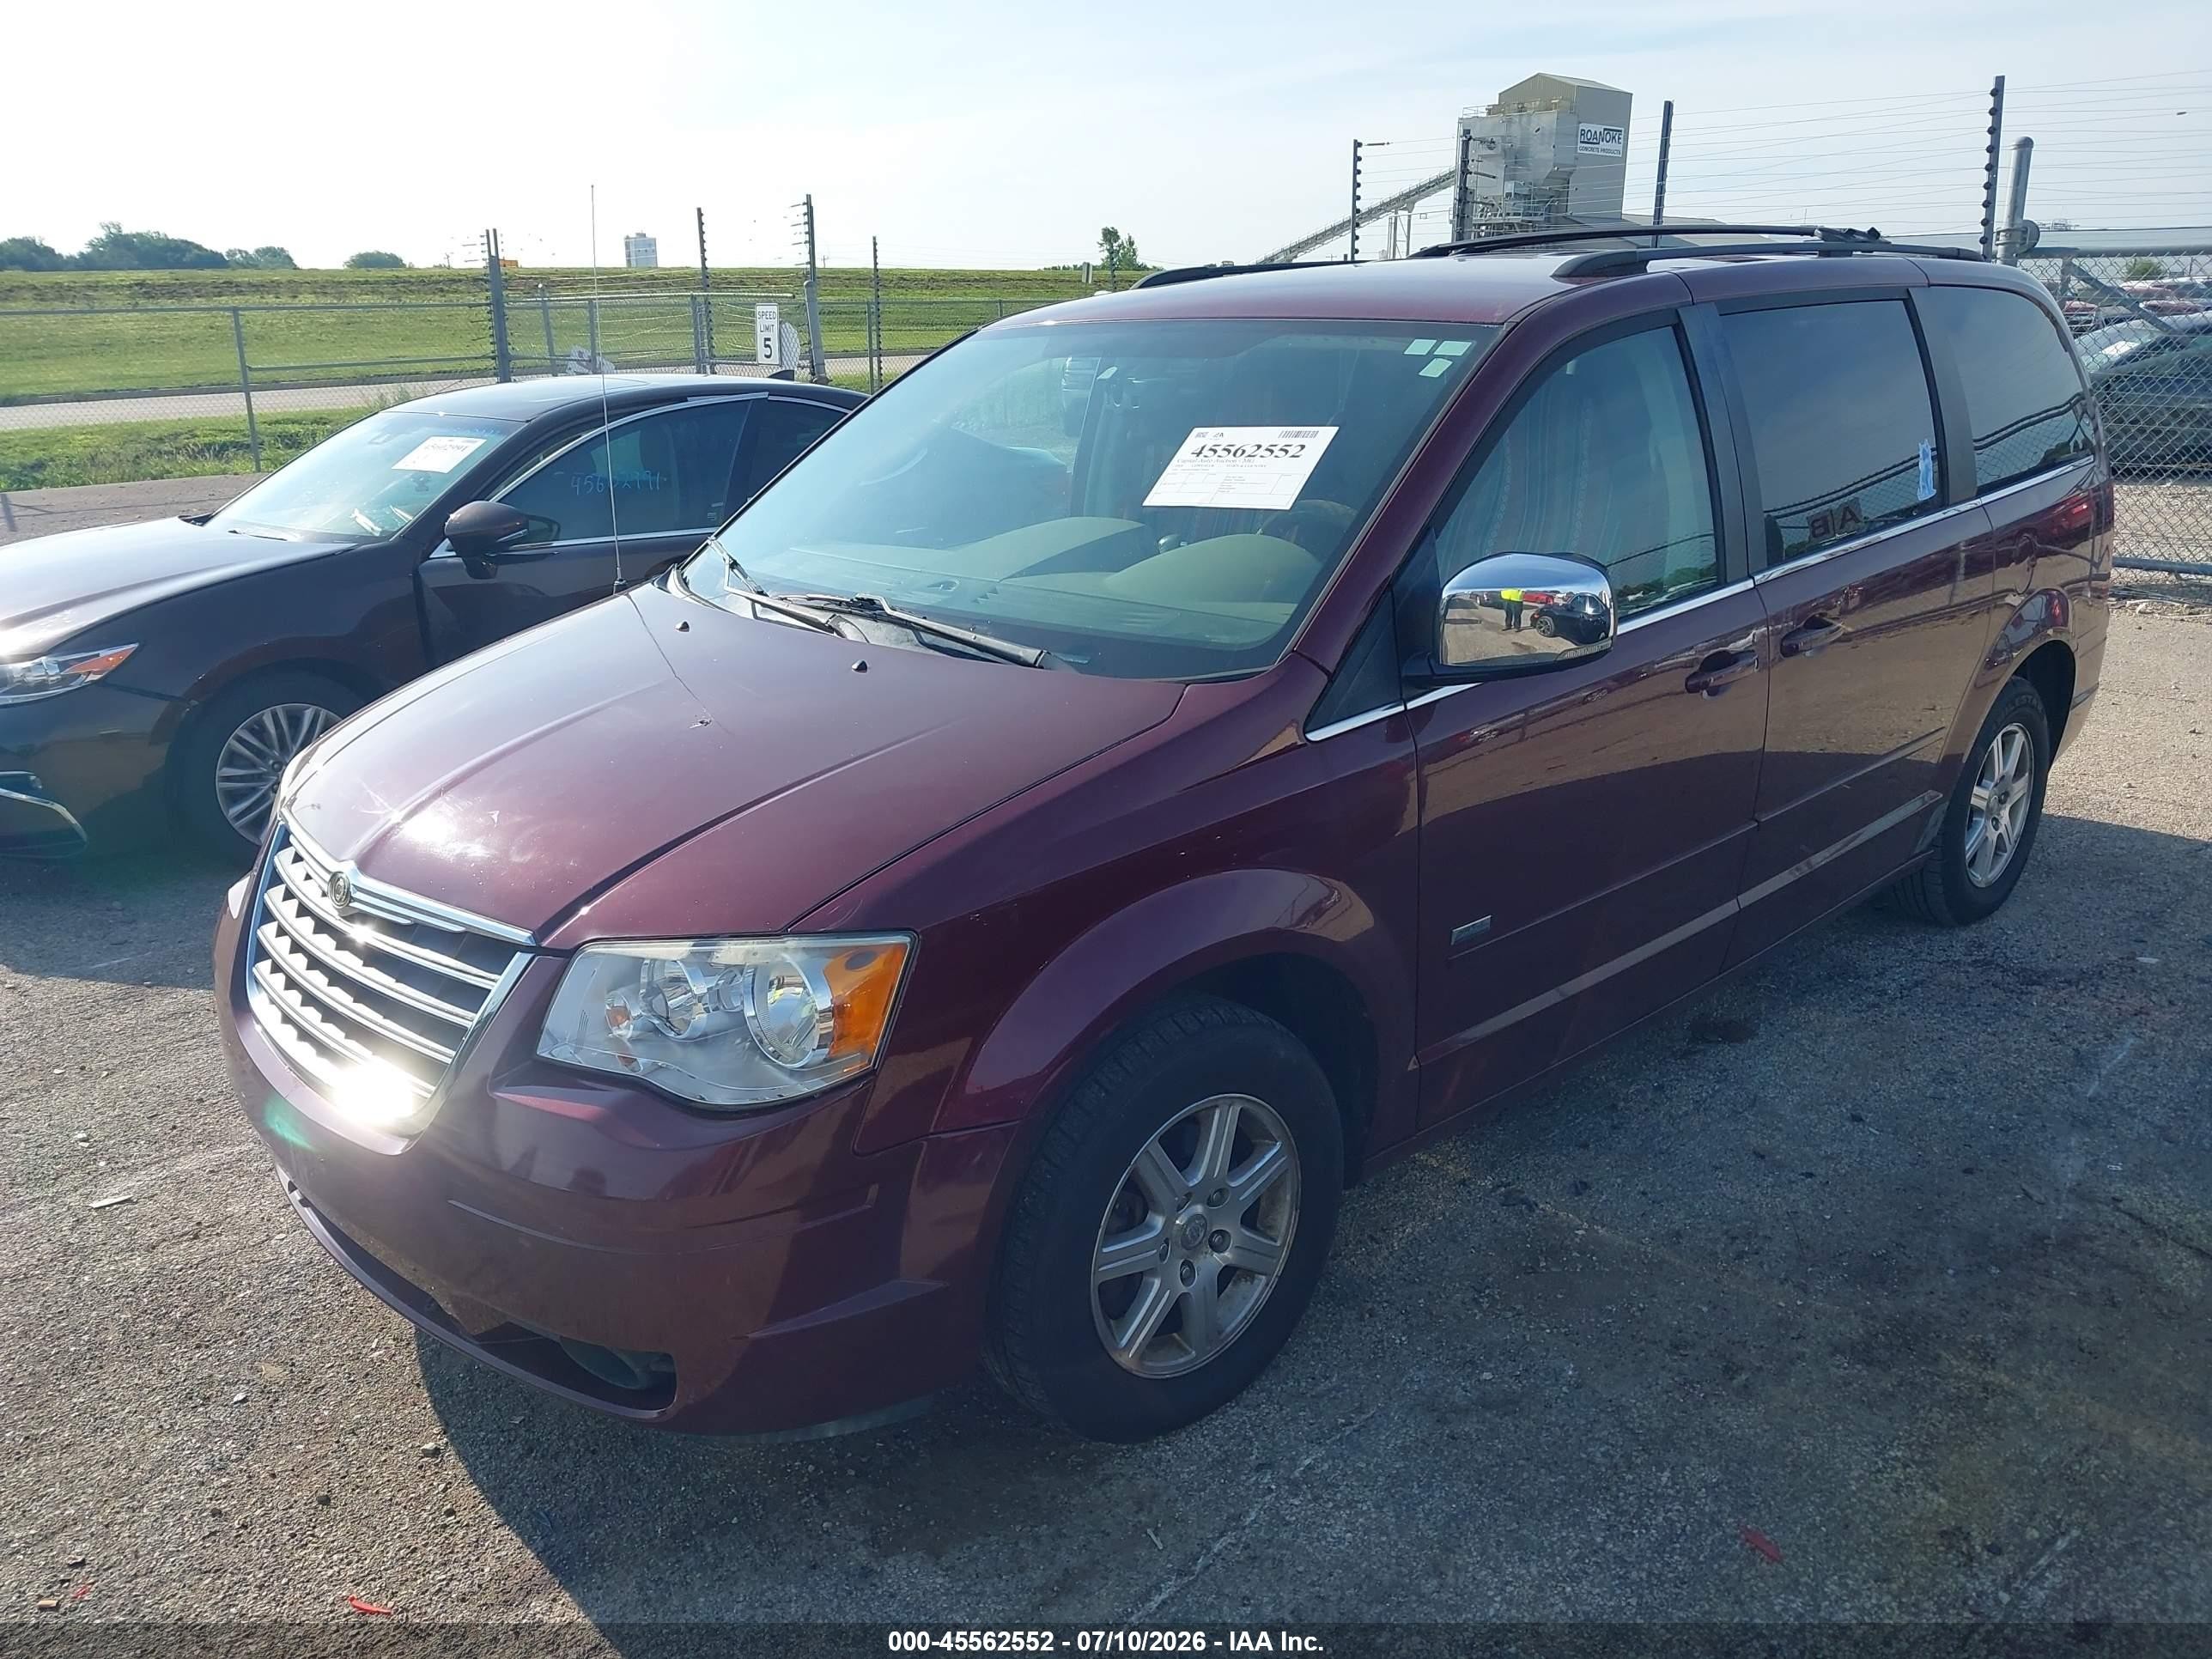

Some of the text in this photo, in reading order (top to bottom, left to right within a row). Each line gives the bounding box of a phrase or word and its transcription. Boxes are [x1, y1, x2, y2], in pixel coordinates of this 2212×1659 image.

[1580, 129, 1622, 144] ROANOKE
[757, 311, 776, 319] SPEED
[760, 325, 775, 333] LIMIT
[763, 337, 773, 359] 5
[1191, 443, 1306, 459] 45562552
